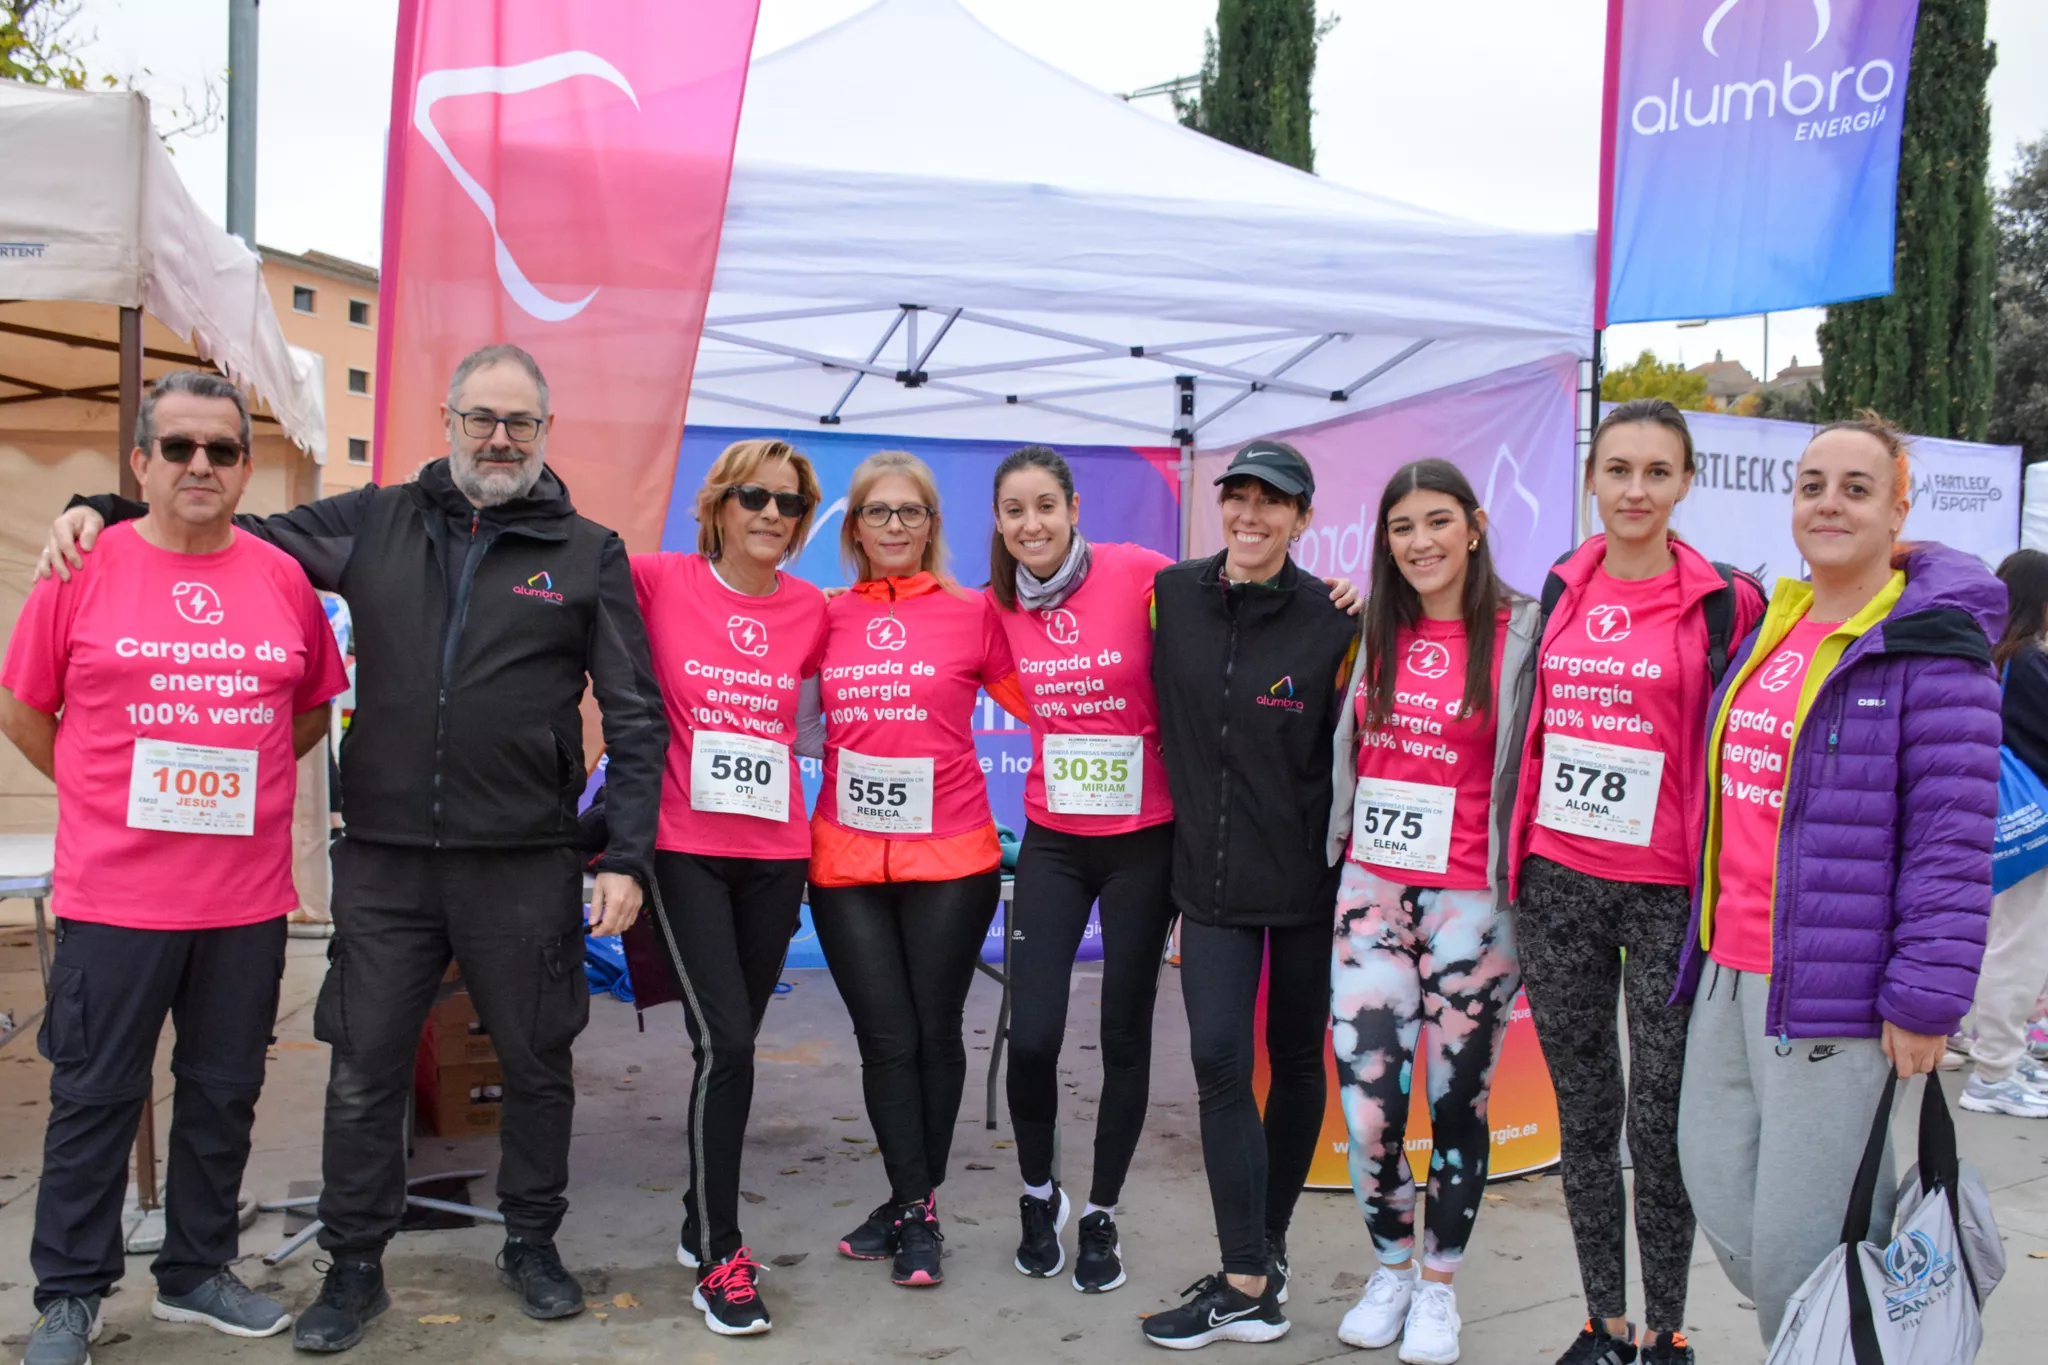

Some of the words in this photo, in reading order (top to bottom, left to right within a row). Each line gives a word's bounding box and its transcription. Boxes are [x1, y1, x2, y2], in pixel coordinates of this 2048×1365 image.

[1795, 104, 1886, 141] ENERGÍA
[1694, 452, 1776, 493] RTLECK
[1934, 474, 1991, 490] FARTLECK
[1939, 496, 1987, 512] SPORT
[115, 637, 246, 664] Cargado
[255, 640, 287, 663] de
[823, 659, 904, 682] Cargada
[910, 661, 935, 676] de
[1019, 653, 1091, 677] Cargada
[1097, 649, 1122, 667] de
[1631, 658, 1662, 679] de
[150, 669, 259, 698] energía
[684, 660, 772, 686] Cargada
[777, 673, 795, 690] de
[1034, 676, 1105, 696] energía
[706, 688, 779, 712] energía
[837, 680, 911, 702] energía
[1552, 683, 1633, 707] energía
[125, 703, 199, 725] 100%
[207, 702, 275, 725] verde
[831, 706, 869, 725] 100%
[873, 704, 928, 721] verde
[1072, 695, 1127, 716] verde
[690, 706, 739, 726] 100%
[742, 717, 785, 734] verde
[1591, 714, 1654, 734] verde
[1402, 744, 1458, 764] verde
[1723, 743, 1782, 774] nergía
[710, 754, 771, 786] 580
[1053, 757, 1128, 782] 3035
[153, 767, 240, 798] 1003
[735, 785, 754, 795] OTI
[848, 777, 907, 806] 555
[1082, 783, 1126, 792] MIRIAM
[1555, 762, 1627, 802] 578
[176, 797, 217, 809] JESUS
[857, 806, 900, 818] REBECA
[1565, 798, 1610, 815] ALONA
[1364, 806, 1423, 840] 575
[1373, 839, 1408, 852] ELENA
[1813, 1044, 1837, 1055] NIKE
